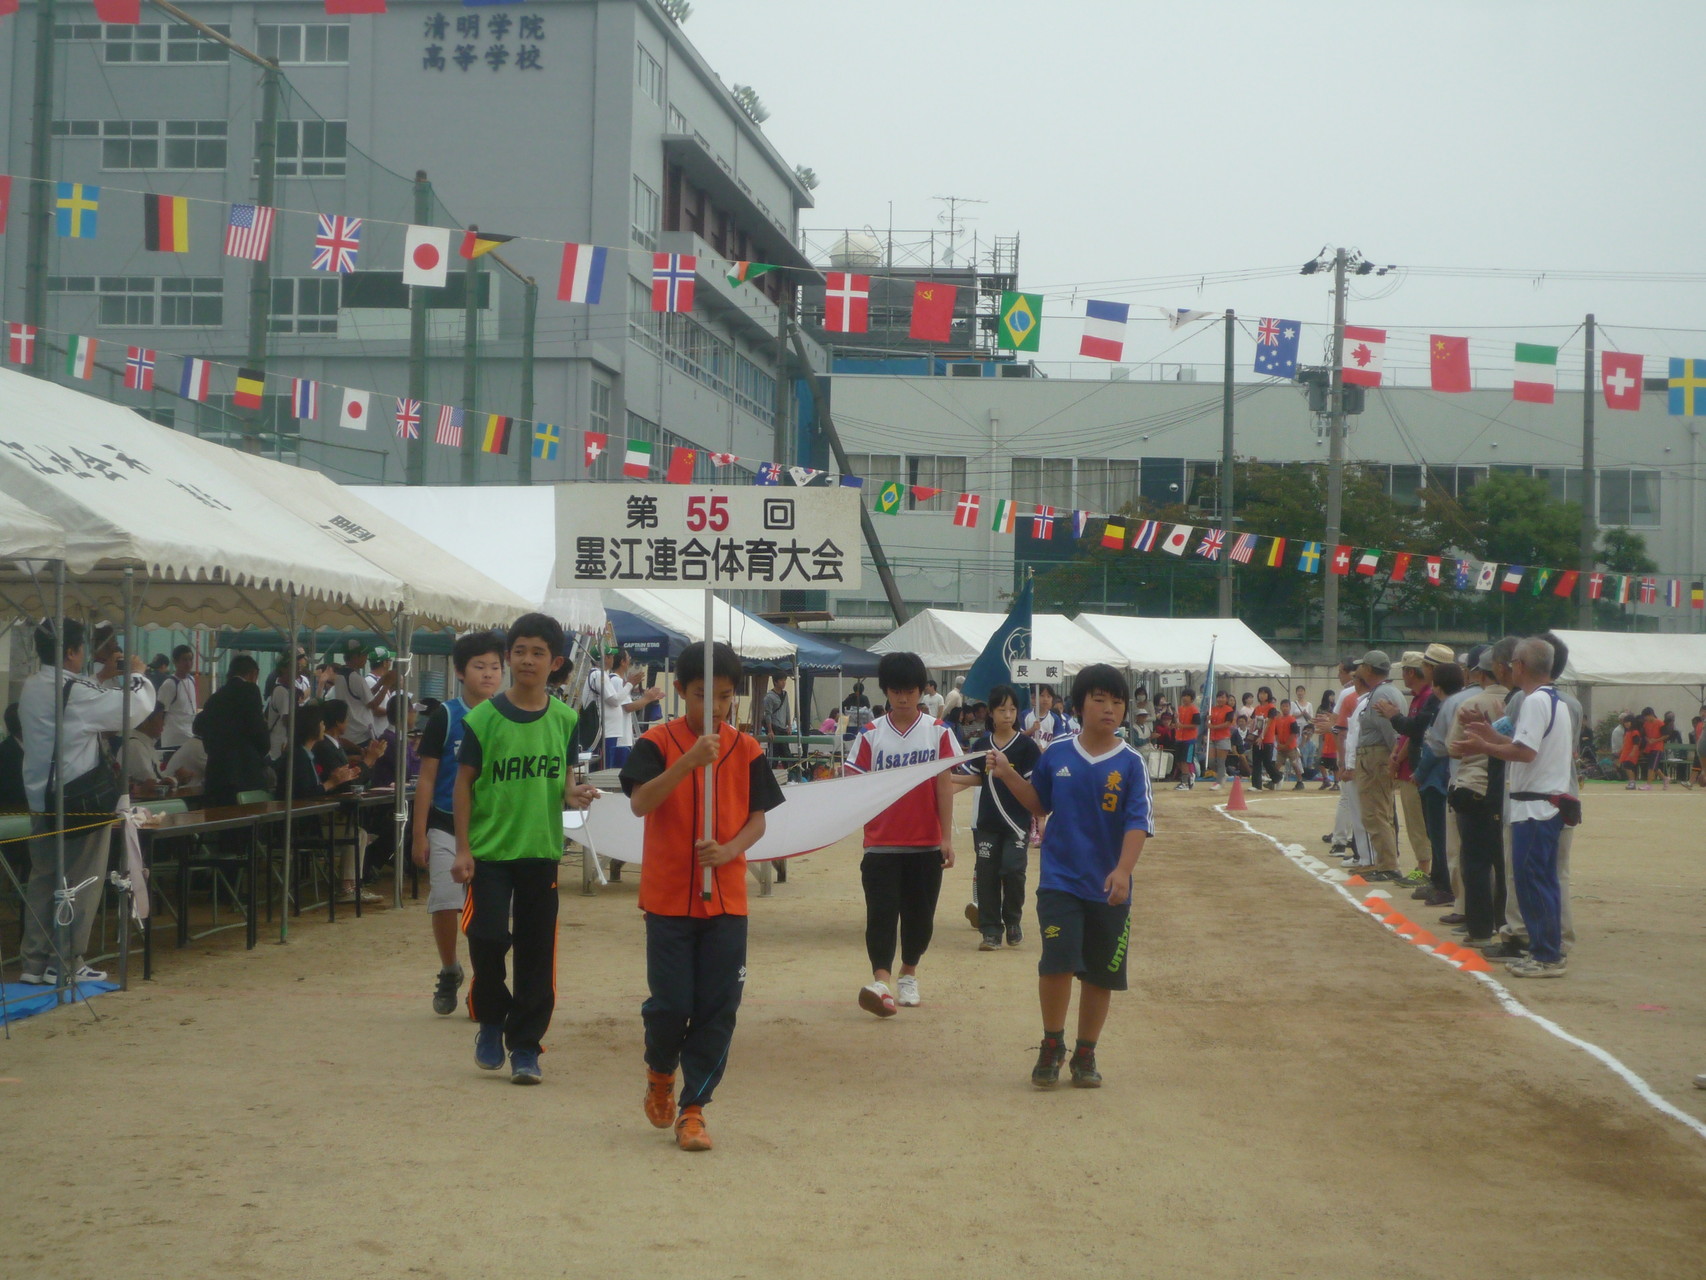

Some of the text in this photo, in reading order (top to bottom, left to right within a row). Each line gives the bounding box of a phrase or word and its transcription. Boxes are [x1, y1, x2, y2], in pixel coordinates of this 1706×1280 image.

[424, 12, 545, 40] 清明学院
[422, 43, 544, 72] 高等学校
[626, 495, 795, 532] 第 55 回
[574, 536, 844, 583] 墨江連合体育大会
[1102, 793, 1118, 811] 3
